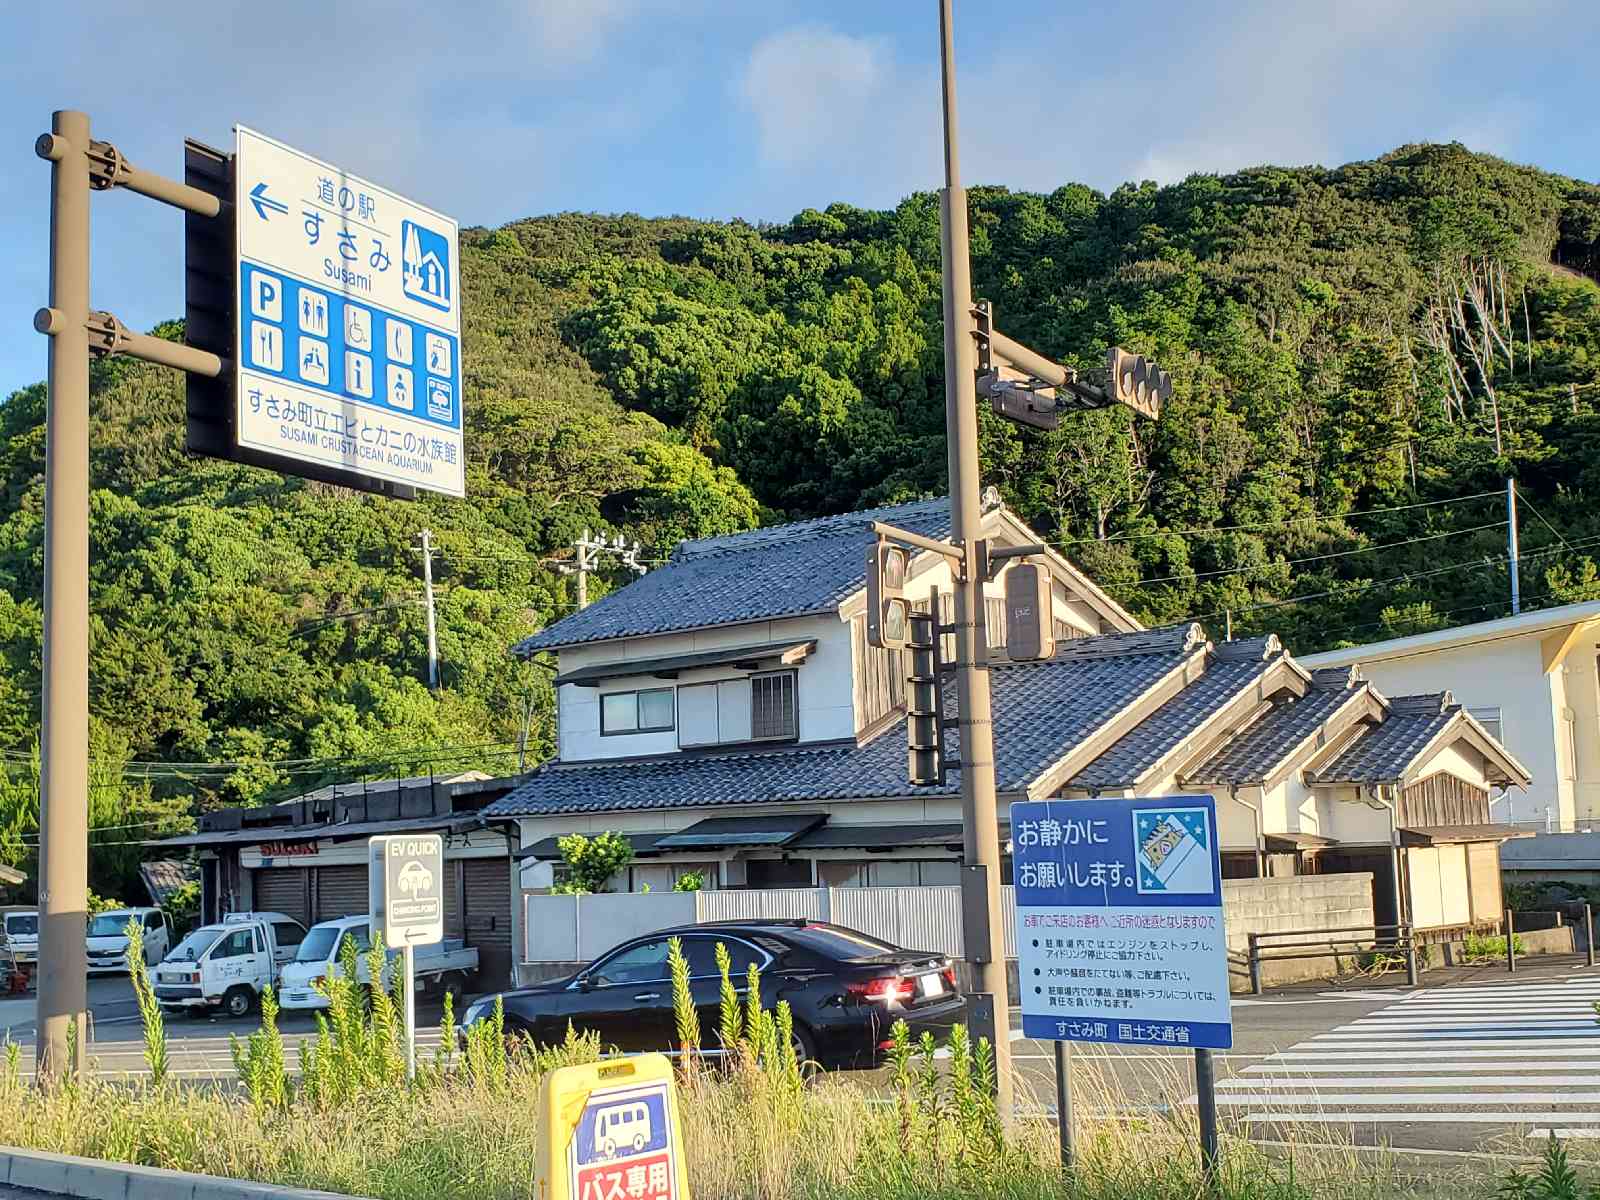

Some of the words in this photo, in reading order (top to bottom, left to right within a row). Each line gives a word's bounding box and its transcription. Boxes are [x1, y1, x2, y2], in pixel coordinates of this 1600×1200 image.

[317, 176, 376, 223] 道の駅
[302, 210, 392, 272] すさみ
[323, 258, 372, 292] Susami
[260, 280, 275, 311] P
[247, 387, 457, 465] すさみ町立エビとカニの水族館
[280, 424, 318, 446] SUSAMI
[321, 435, 384, 463] CRUSTACEAN
[387, 453, 434, 474] AQUARIUM
[391, 842, 405, 857] EV
[407, 840, 438, 857] QUICK
[1018, 818, 1109, 847] お静かに
[1019, 861, 1135, 889] お願いします。
[1055, 1021, 1108, 1040] すさみ町
[1118, 1023, 1191, 1043] 国土交通省
[581, 1160, 670, 1200] バス専用
